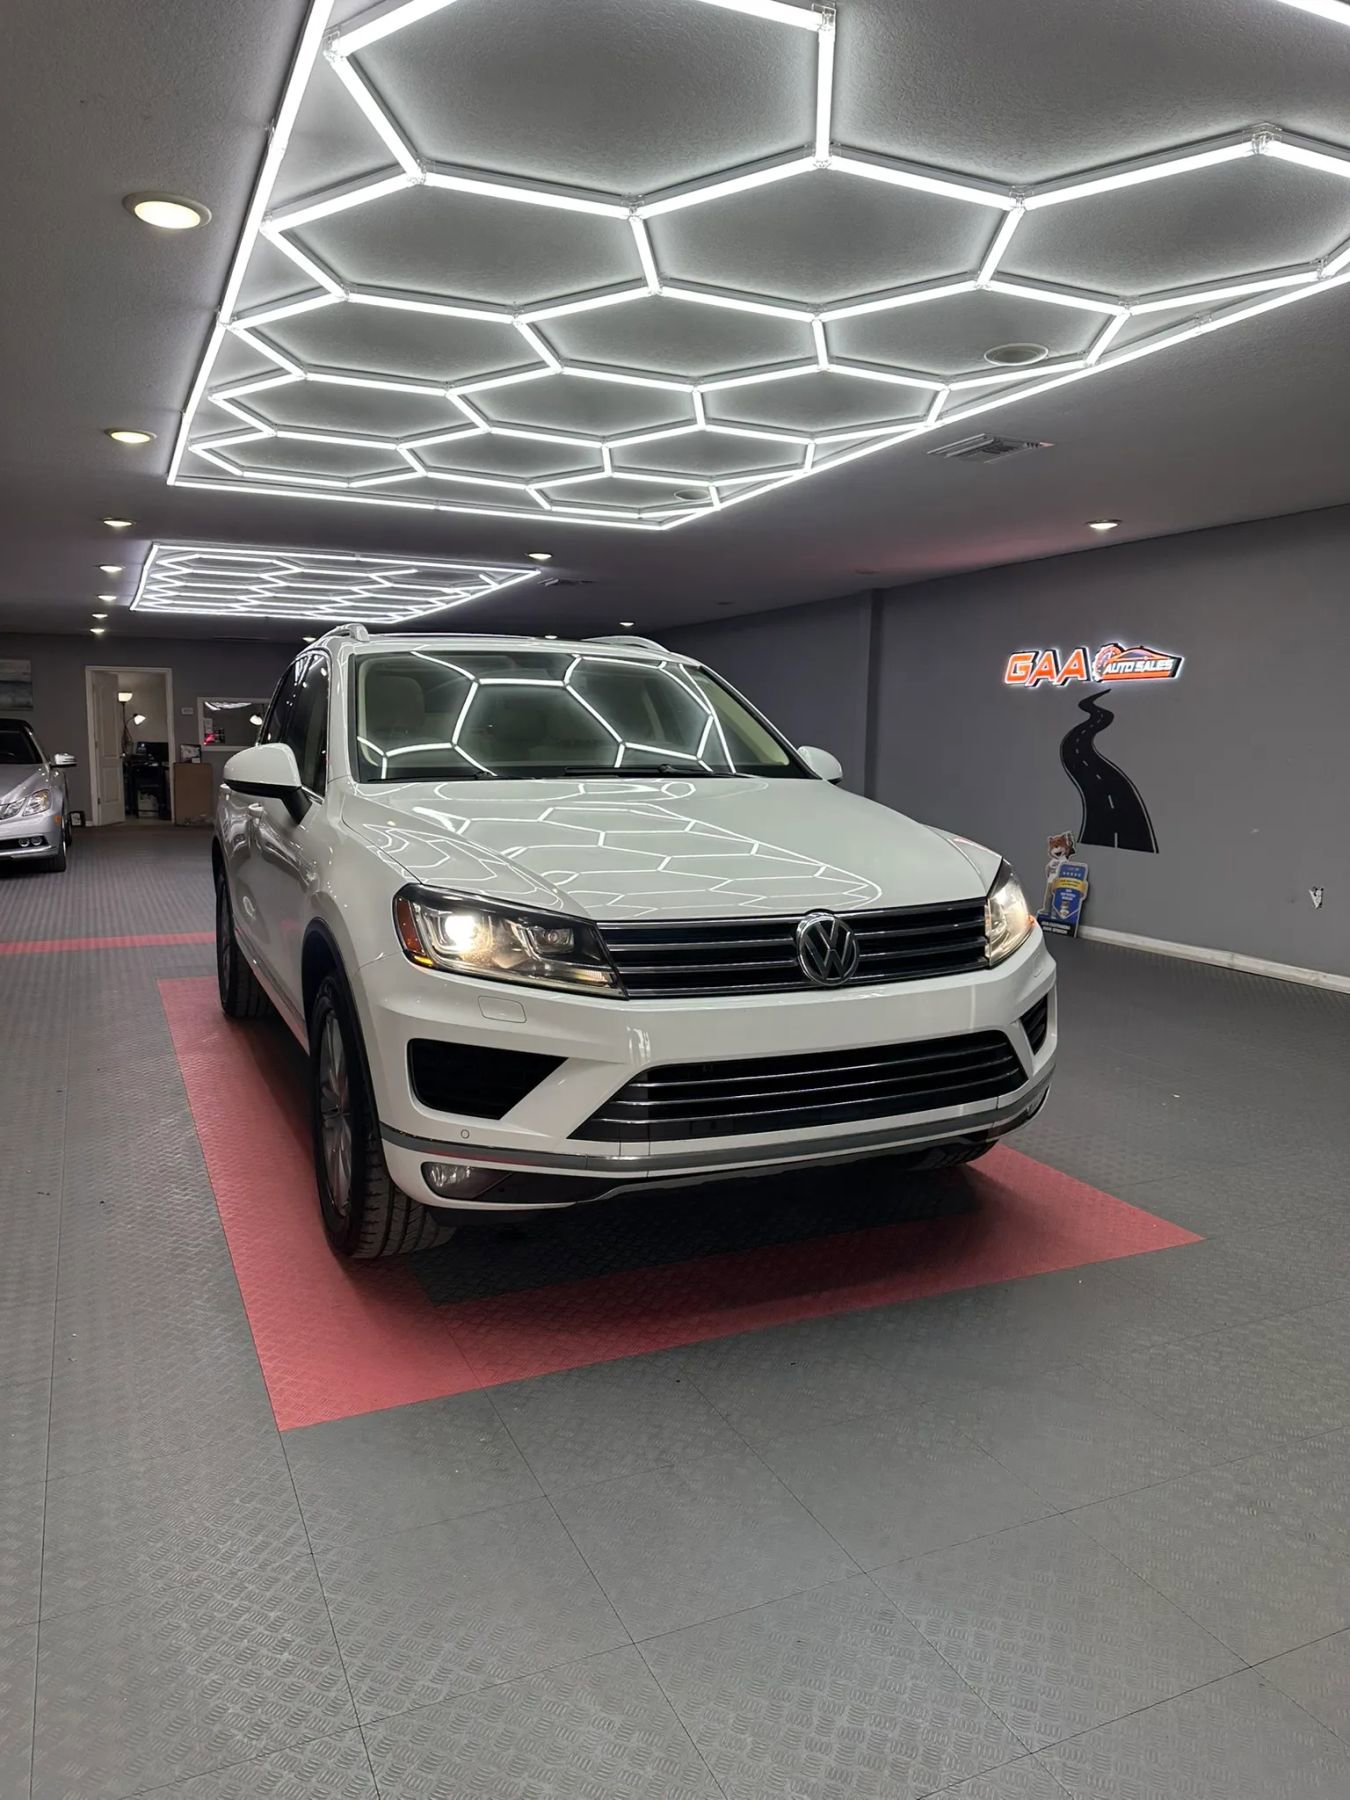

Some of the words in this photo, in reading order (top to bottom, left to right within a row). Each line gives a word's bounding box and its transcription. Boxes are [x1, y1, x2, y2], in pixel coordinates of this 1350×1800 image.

[1005, 647, 1089, 686] GAA
[1103, 661, 1134, 675] AUTO
[1134, 659, 1174, 673] SALES
